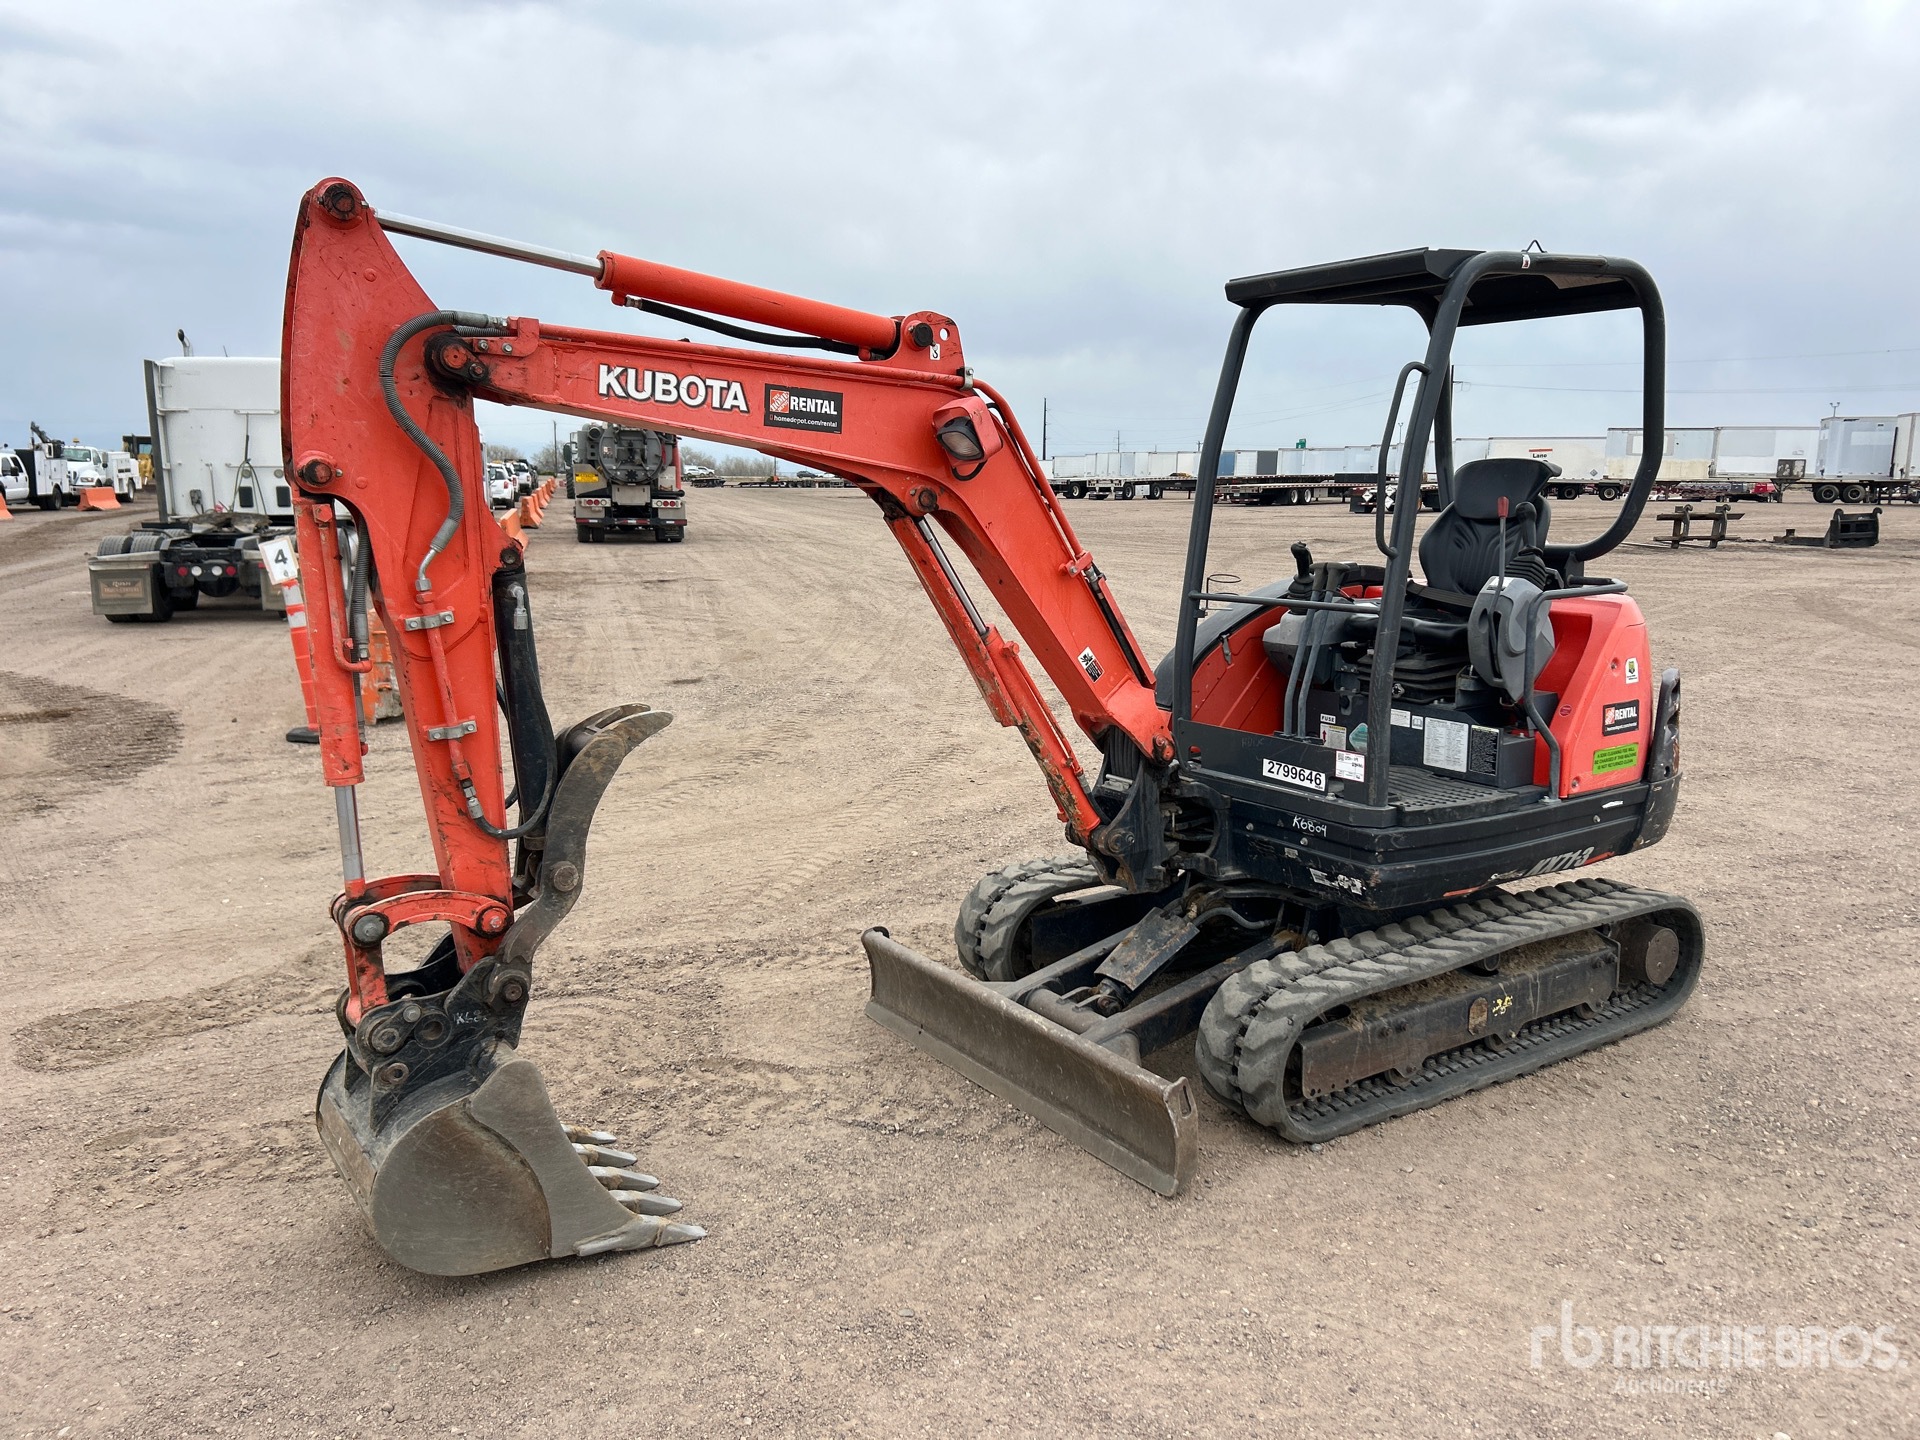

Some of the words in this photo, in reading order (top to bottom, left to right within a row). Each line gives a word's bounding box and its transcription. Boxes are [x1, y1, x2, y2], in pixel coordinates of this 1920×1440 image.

[598, 363, 750, 414] KUBOTA
[790, 396, 837, 415] RENTAL
[774, 415, 837, 427] homedepot.com/rental
[274, 548, 288, 565] 4
[1615, 706, 1637, 720] RENTAL
[1267, 760, 1322, 786] 2799646
[1292, 814, 1327, 838] K6804
